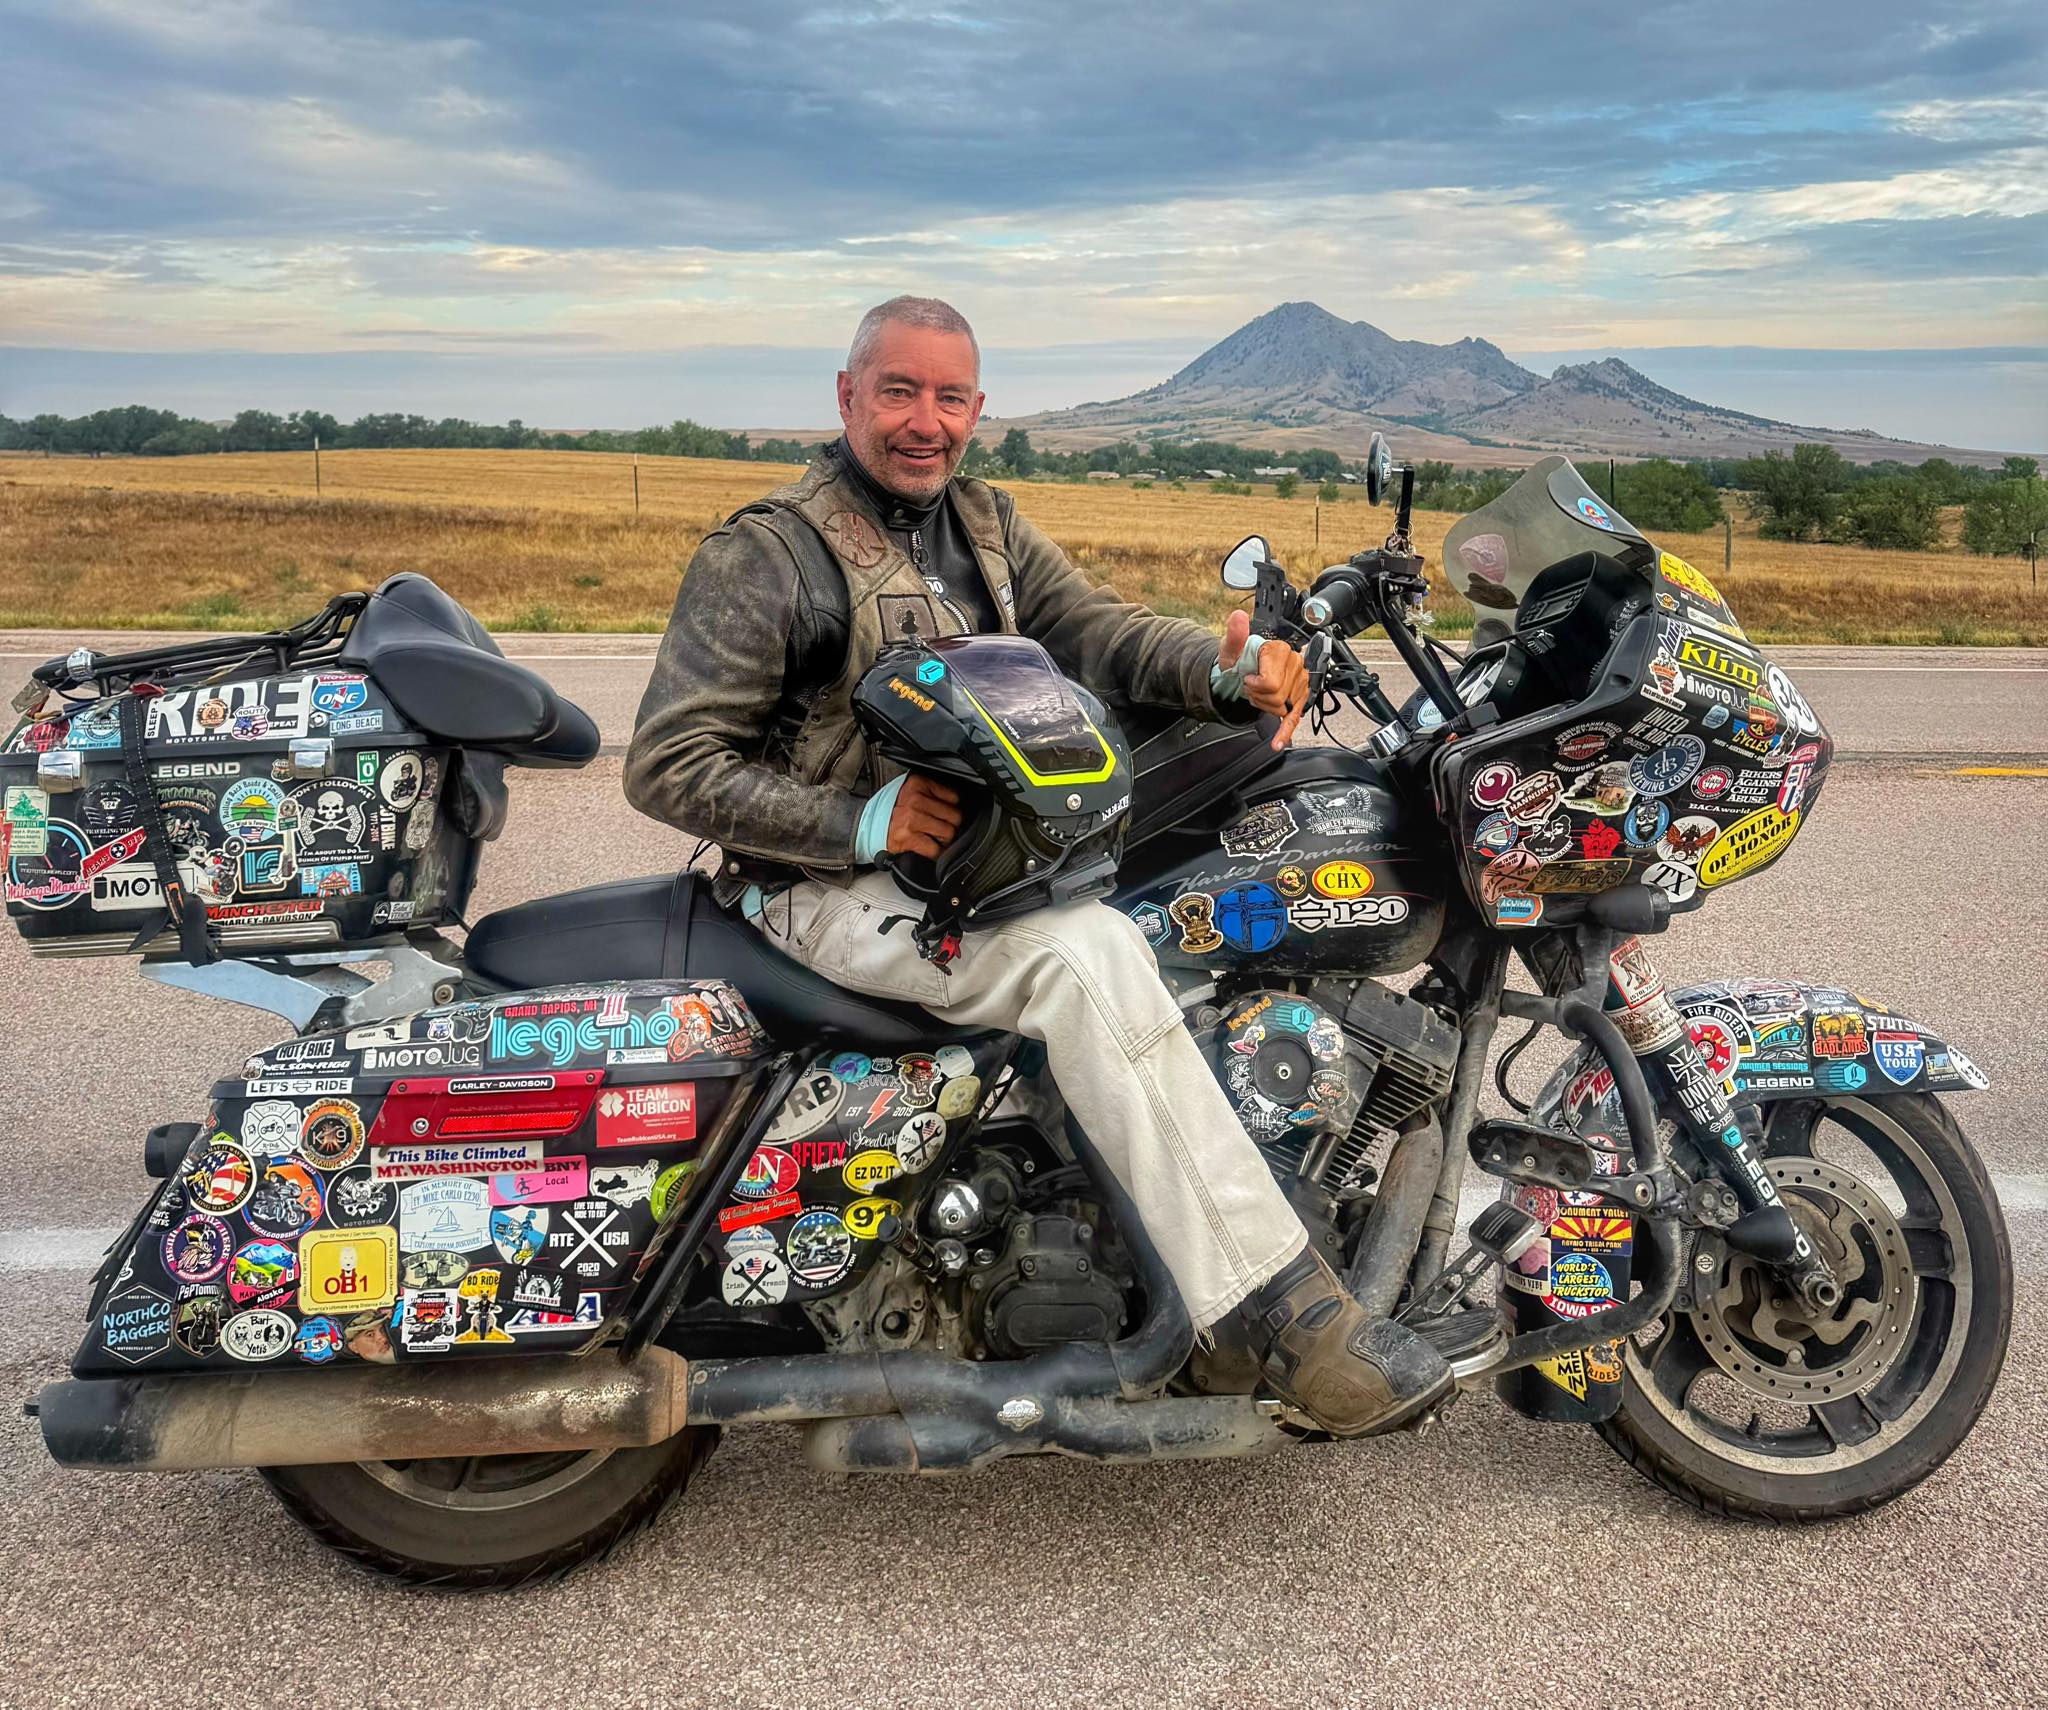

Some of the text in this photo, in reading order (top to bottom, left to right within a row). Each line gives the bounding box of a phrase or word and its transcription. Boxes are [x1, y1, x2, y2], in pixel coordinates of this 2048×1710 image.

[1679, 641, 1759, 686] Klim
[318, 692, 360, 705] ONE
[888, 678, 936, 712] legend
[144, 674, 316, 739] RIDE
[238, 708, 265, 717] ROUTE
[147, 707, 158, 738] SLEEP
[268, 720, 297, 728] EPEAT
[331, 716, 381, 732] LONG BEACH
[1642, 706, 1690, 735] UNITED
[166, 735, 227, 745] MOTOTOMIC
[1627, 721, 1674, 747] WE RIDE
[1732, 727, 1774, 753] CYCLES
[359, 754, 376, 762] MILE
[362, 763, 375, 778] 0
[1630, 753, 1700, 792] BREWING COMPANY
[1739, 769, 1783, 779] BIKERS
[293, 783, 320, 801] DON'T
[319, 780, 358, 791] FOLLOW
[1730, 786, 1769, 796] CHILD
[1734, 778, 1783, 788] AGAINST
[222, 797, 233, 820] Rolling
[242, 780, 262, 789] Roads
[1509, 783, 1556, 812] HANNUM'S
[1235, 825, 1289, 853] ON 2 WHEELS
[1727, 814, 1774, 848] TOUR
[1708, 852, 1731, 874] OF
[1735, 816, 1793, 859] HONOR
[1160, 841, 1405, 897] Harley-Davidson
[1323, 872, 1364, 890] CHX
[1534, 869, 1623, 887] STURGIS
[1649, 863, 1695, 896] TX
[8, 881, 50, 902] Mileage
[207, 900, 322, 919] MANCHESTER
[1334, 899, 1406, 924] 120
[222, 913, 315, 927] HARLEY-DAVIDSON
[1135, 912, 1162, 929] 25
[505, 999, 597, 1018] GRAND RAPIDS, MI
[1227, 995, 1272, 1031] legend
[1688, 1005, 1747, 1039] FIRE RIDERS
[492, 1000, 680, 1067] legend
[279, 1041, 333, 1059] HOT BIKE
[1815, 1041, 1869, 1055] BADLANDS
[1881, 1044, 1917, 1058] USA
[264, 1060, 351, 1072] NELSON-RIGG
[1716, 1055, 1730, 1067] NY
[1772, 1062, 1809, 1072] SESSIONS
[1884, 1058, 1918, 1069] TOUR
[1747, 1077, 1814, 1089] LEGEND
[1967, 1065, 1989, 1087] ADV
[250, 1079, 349, 1093] LET'S RIDE
[453, 1079, 549, 1091] HARLEY-DAVIDSON
[1678, 1068, 1720, 1110] UNIT
[626, 1086, 670, 1101] TEAM
[626, 1099, 691, 1119] RUBICON
[845, 1107, 863, 1117] EST
[892, 1107, 914, 1117] 2019
[1690, 1104, 1715, 1125] WE
[388, 1146, 526, 1163] This Bike Climbed
[545, 1176, 569, 1185] Local
[855, 1165, 896, 1181] EZ DZ IT
[421, 1181, 472, 1194] IN MEMORY OF
[738, 1186, 780, 1197] INDIANA
[423, 1191, 439, 1202] MIKE
[440, 1190, 462, 1201] CARLO
[574, 1201, 608, 1210] LIVE TO RIDE
[1561, 1207, 1601, 1218] ONUMENT
[574, 1210, 607, 1218] RIDE TO EAT
[550, 1231, 630, 1247] RTE USA
[1561, 1239, 1584, 1247] NAVAJO
[1605, 1241, 1622, 1249] PARK
[577, 1262, 600, 1272] 2020
[1556, 1263, 1597, 1273] WORLD'S
[726, 1282, 745, 1290] Irish
[811, 1281, 824, 1289] RTE
[1558, 1274, 1600, 1285] LARGEST
[257, 1287, 285, 1304] Alaska
[1552, 1286, 1610, 1298] TRUCKSTOP
[1549, 1297, 1588, 1318] IOWA
[102, 1302, 172, 1330] NORTHCO
[250, 1315, 273, 1326] Bart
[106, 1320, 171, 1346] BAGGERS
[1558, 1361, 1582, 1377] ME
[1587, 1368, 1620, 1382] RIDES
[1568, 1376, 1585, 1393] IN
